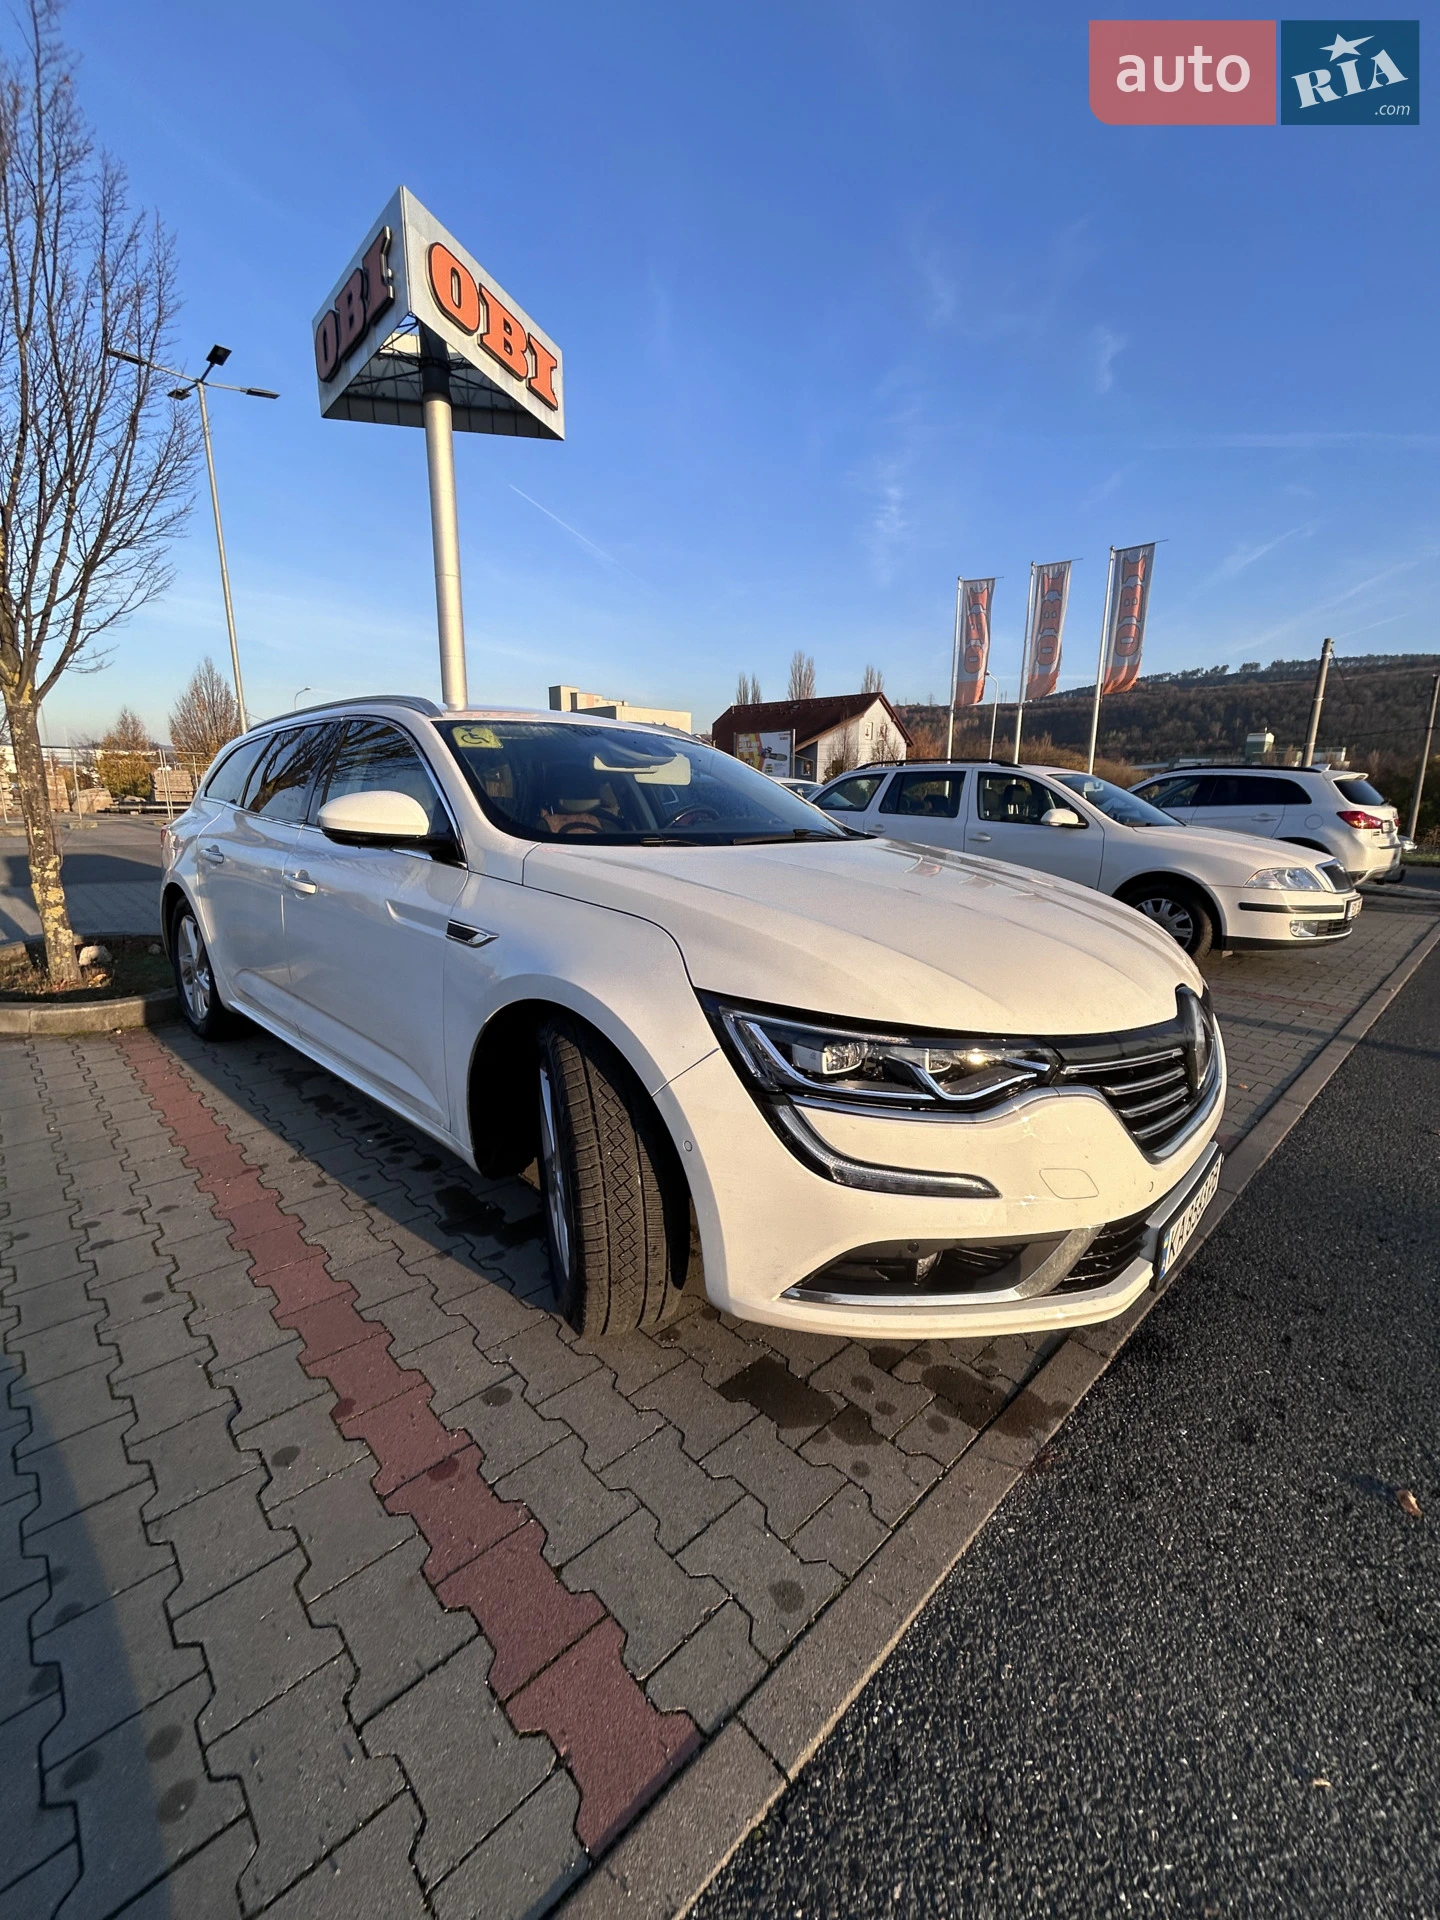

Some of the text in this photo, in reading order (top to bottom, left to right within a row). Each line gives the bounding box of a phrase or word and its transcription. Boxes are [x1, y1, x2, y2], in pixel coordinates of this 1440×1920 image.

[315, 225, 394, 383] OBI
[427, 242, 559, 412] OBI
[964, 587, 988, 674] OBI
[1036, 571, 1064, 666] OBI
[1114, 555, 1147, 657] OBI
